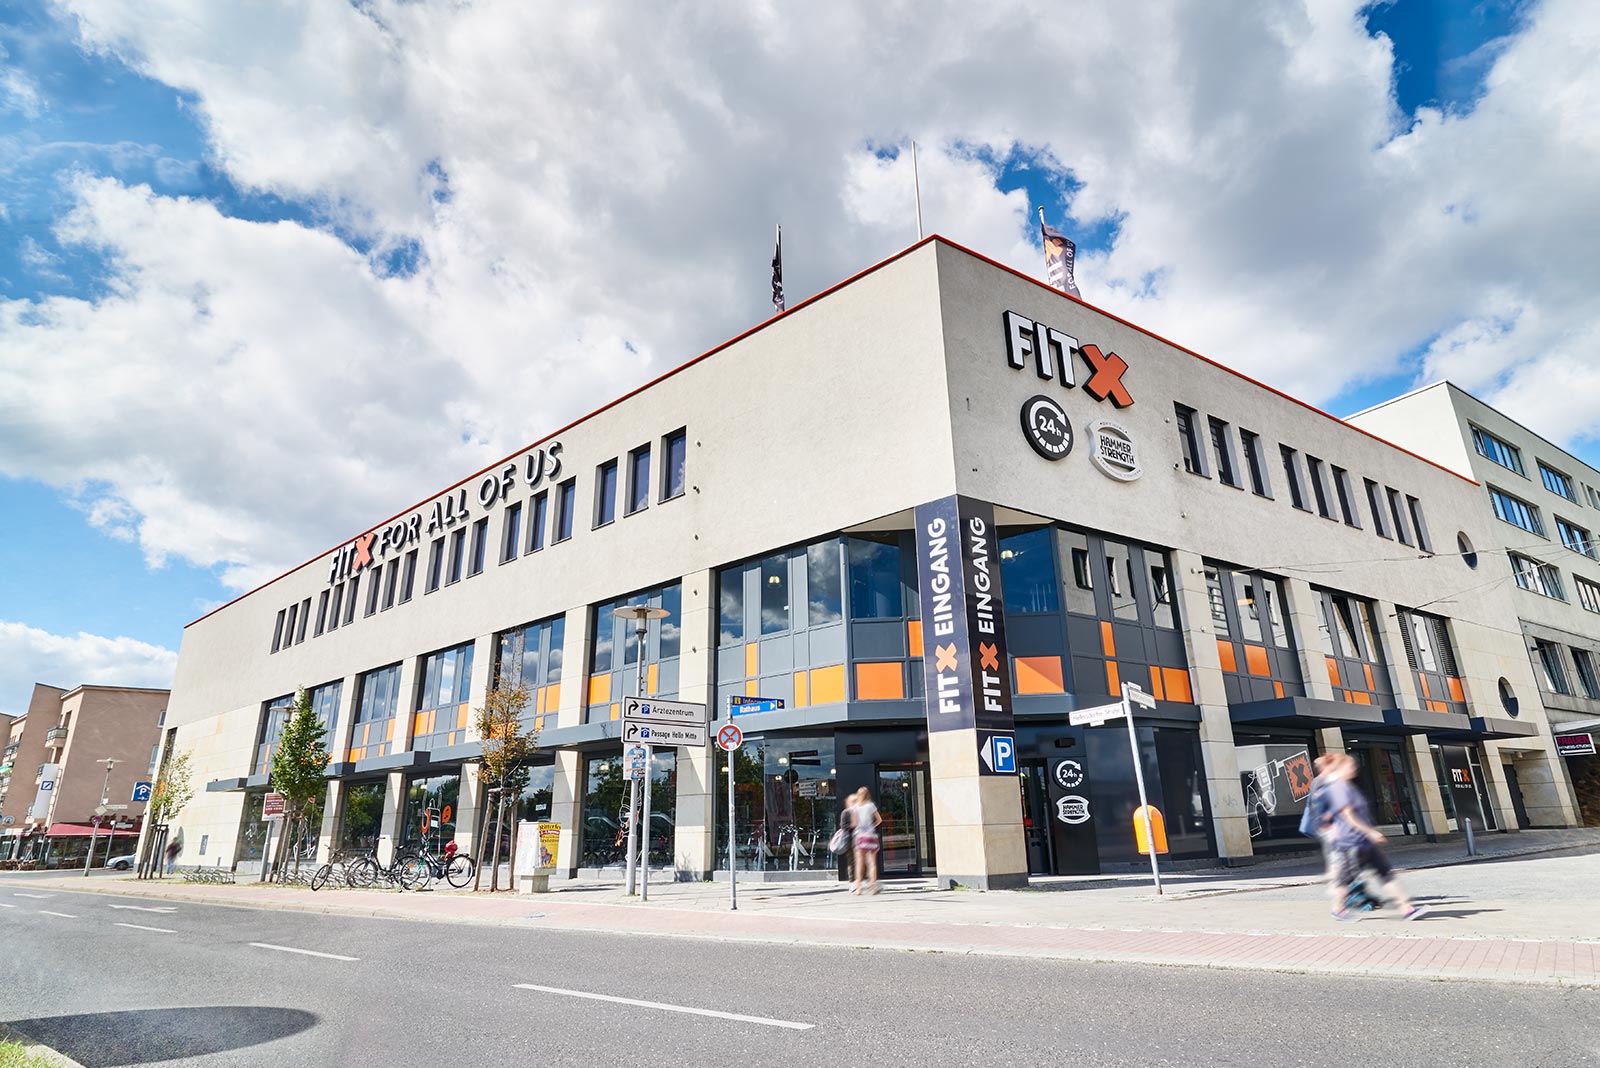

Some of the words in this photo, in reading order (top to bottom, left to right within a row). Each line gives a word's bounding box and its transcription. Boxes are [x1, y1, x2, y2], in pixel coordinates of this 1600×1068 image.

[1003, 310, 1135, 409] FITX
[1100, 435, 1132, 454] HAMMER
[1100, 446, 1135, 464] STRENGTH
[327, 532, 378, 585] FITX
[379, 513, 422, 558] FOR
[425, 489, 470, 535] ALL
[478, 464, 517, 507] OF
[524, 441, 563, 486] US
[927, 517, 954, 637] EINGANG
[969, 516, 995, 635] EINGANG
[935, 642, 961, 714] FITX
[979, 641, 1003, 712] FITX
[651, 729, 670, 739] Passage
[998, 742, 1011, 766] P
[1556, 735, 1591, 746] FRAUEN
[1451, 768, 1471, 782] FITX
